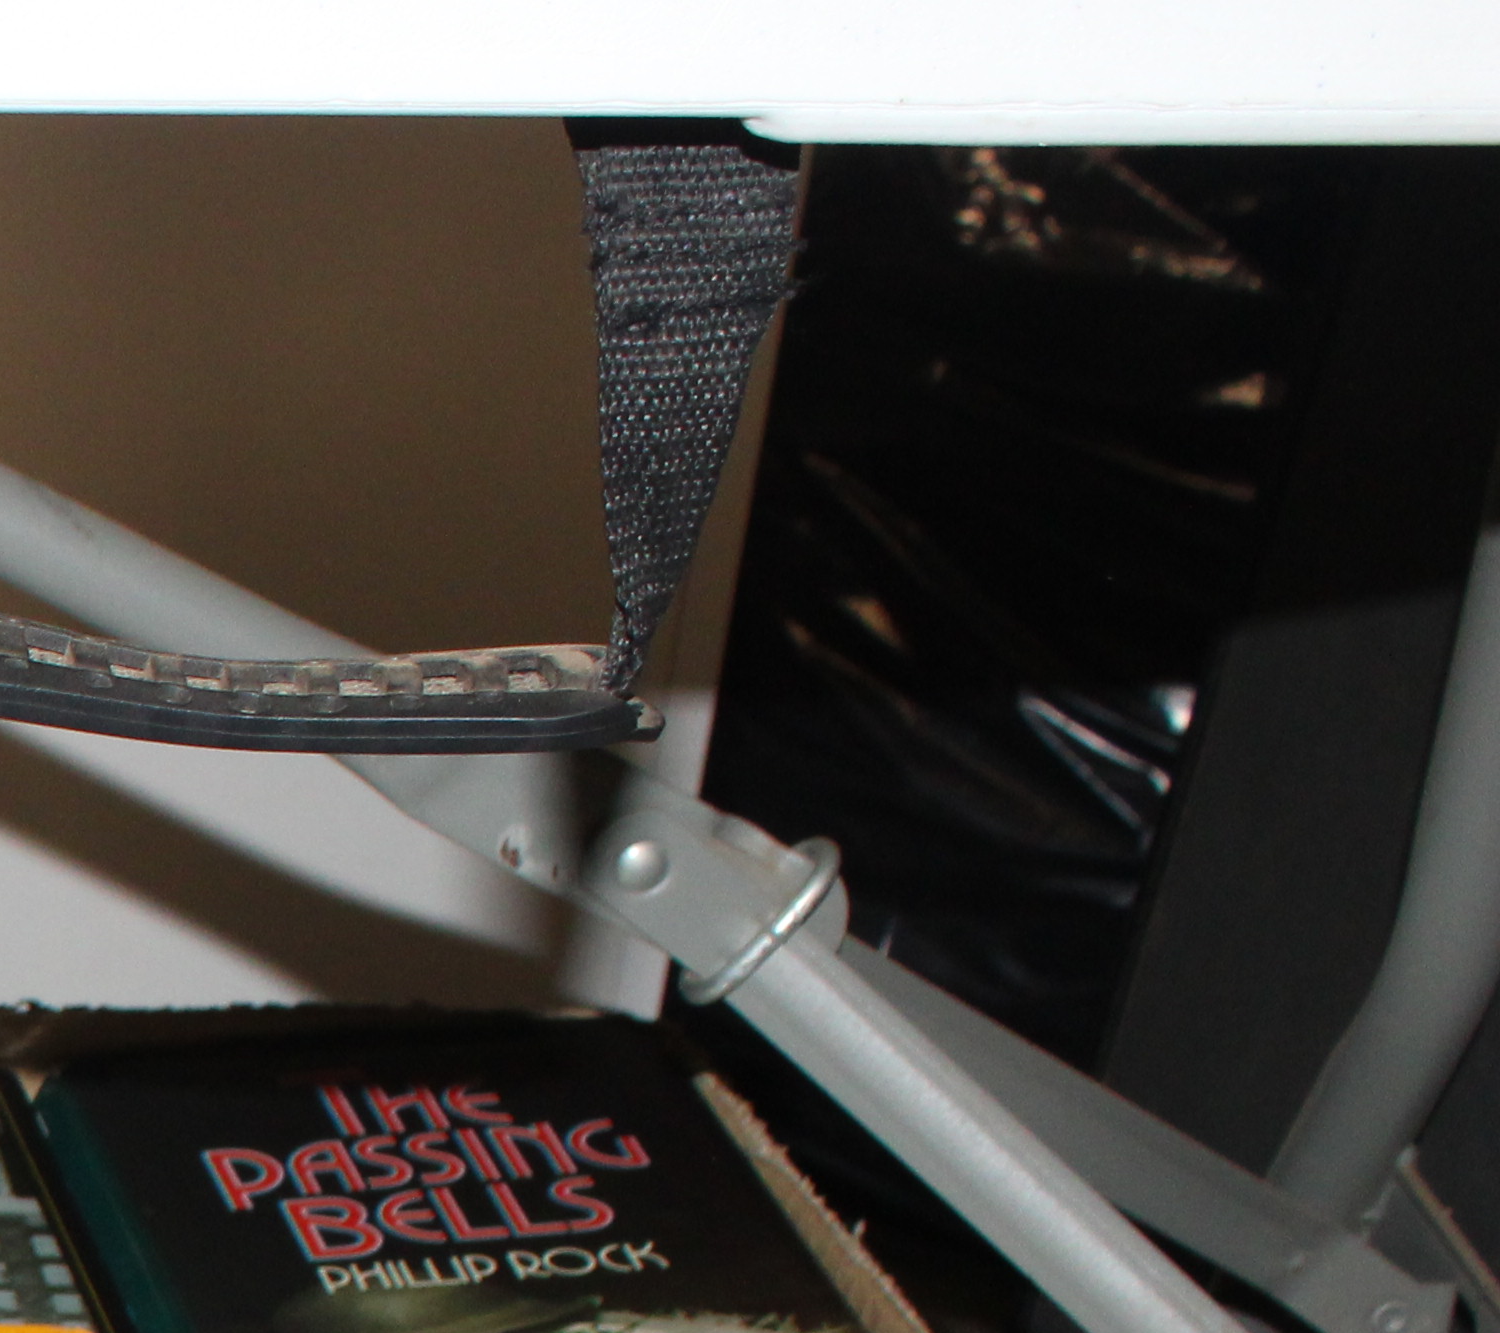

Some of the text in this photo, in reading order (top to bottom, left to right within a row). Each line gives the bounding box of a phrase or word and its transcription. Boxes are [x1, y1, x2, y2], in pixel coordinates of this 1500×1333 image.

[316, 1082, 512, 1137] THE
[201, 1117, 650, 1211] PASSING
[279, 1176, 616, 1262] BELLS
[316, 1238, 670, 1295] PHILLIP ROCK
